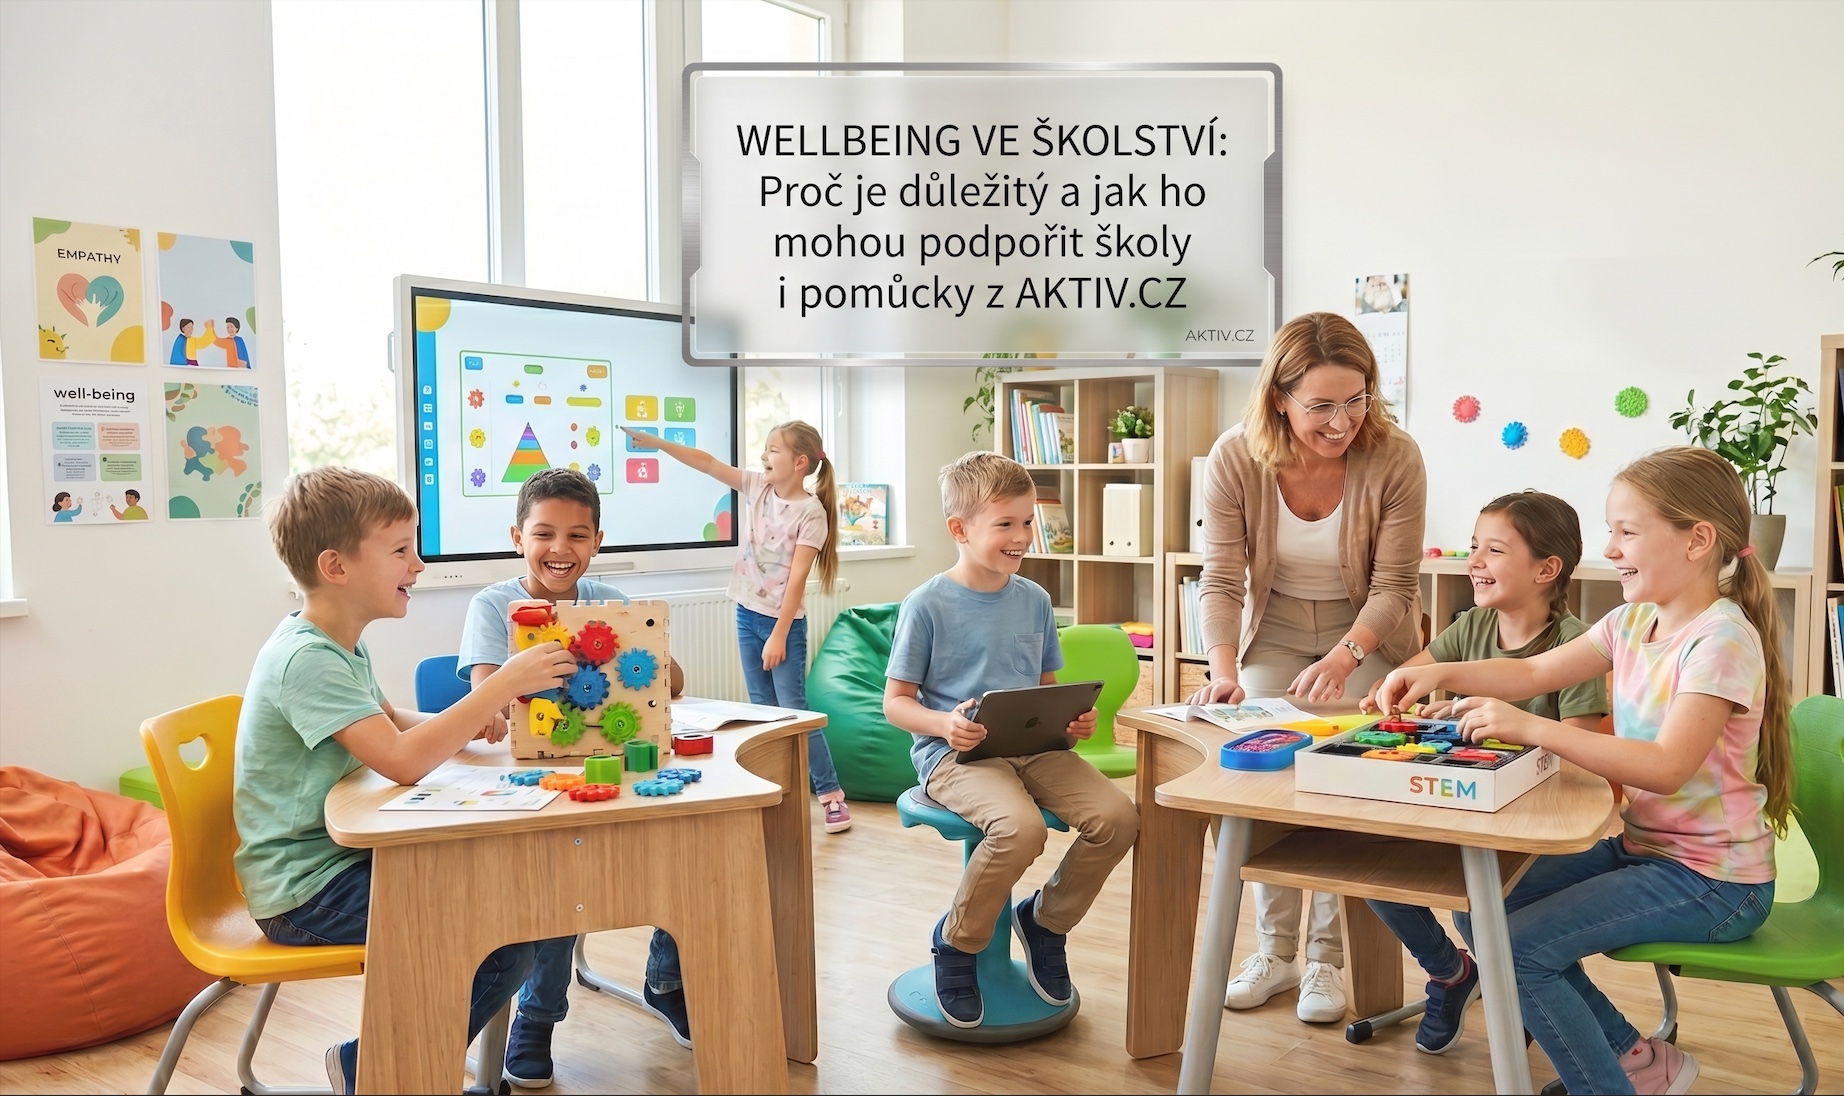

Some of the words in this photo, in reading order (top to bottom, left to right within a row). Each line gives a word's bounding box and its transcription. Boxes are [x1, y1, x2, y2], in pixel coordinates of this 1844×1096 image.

[56, 248, 122, 265] EMPATHY
[53, 387, 135, 404] well-being
[1409, 775, 1477, 800] STEM
